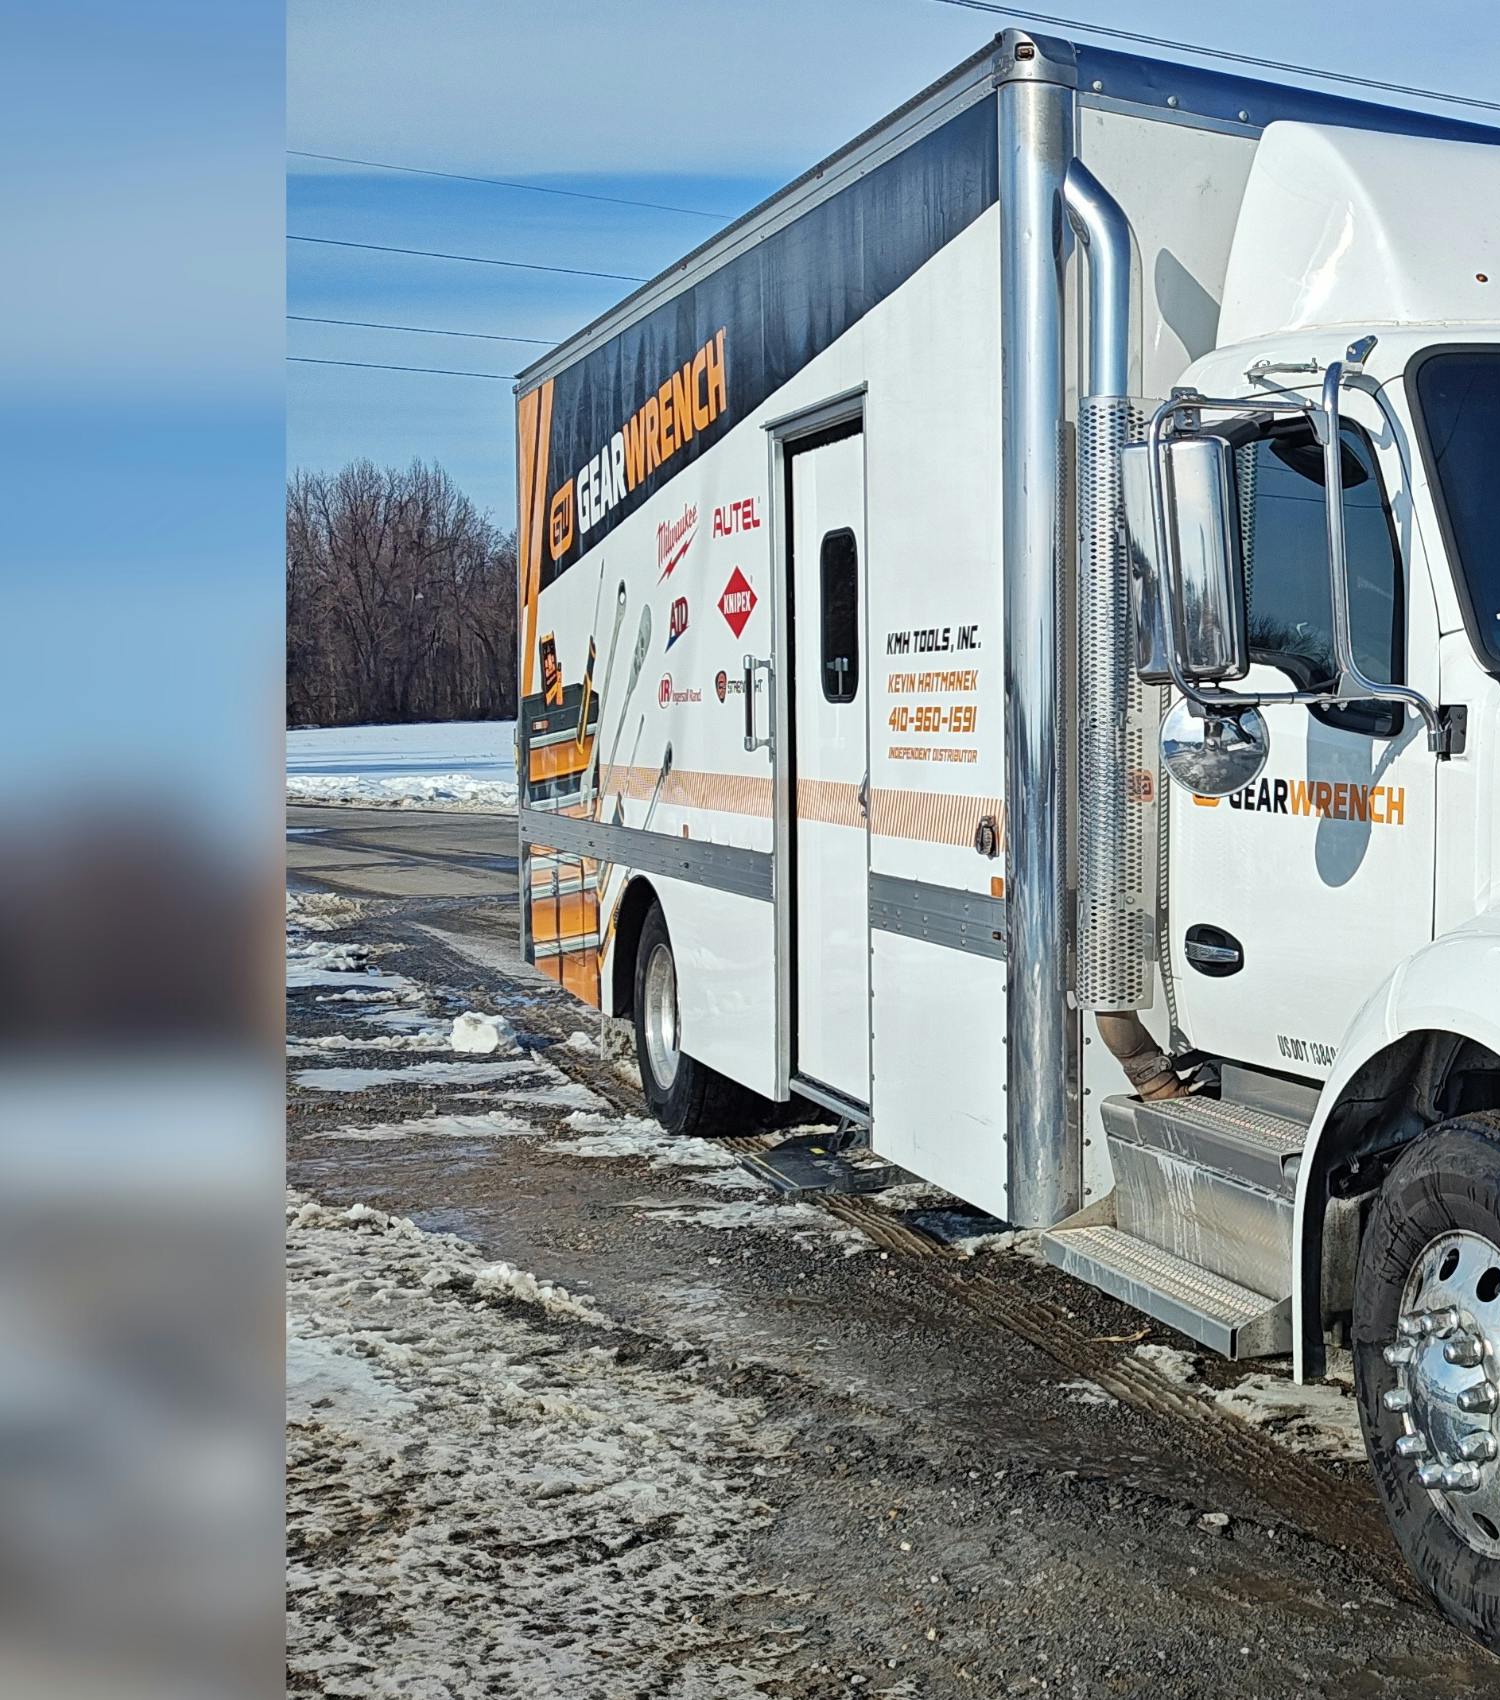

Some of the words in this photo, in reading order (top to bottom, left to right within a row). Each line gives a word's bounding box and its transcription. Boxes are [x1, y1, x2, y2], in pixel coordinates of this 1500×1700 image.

[576, 329, 728, 534] GEARWRENCH
[712, 498, 760, 538] AUTEL
[656, 502, 698, 568] Milwaukee
[724, 591, 751, 614] KNIPEX
[886, 631, 911, 655] KMH
[913, 627, 954, 653] TOOLS,
[957, 625, 982, 650] INC.
[888, 672, 916, 693] KEVIN
[917, 670, 979, 692] HAITMANEK
[888, 705, 978, 733] 410-960-1591
[888, 747, 931, 761] INDEPENDENT
[932, 748, 978, 763] DISTRIBUTOR
[1290, 1038, 1310, 1063] DOT
